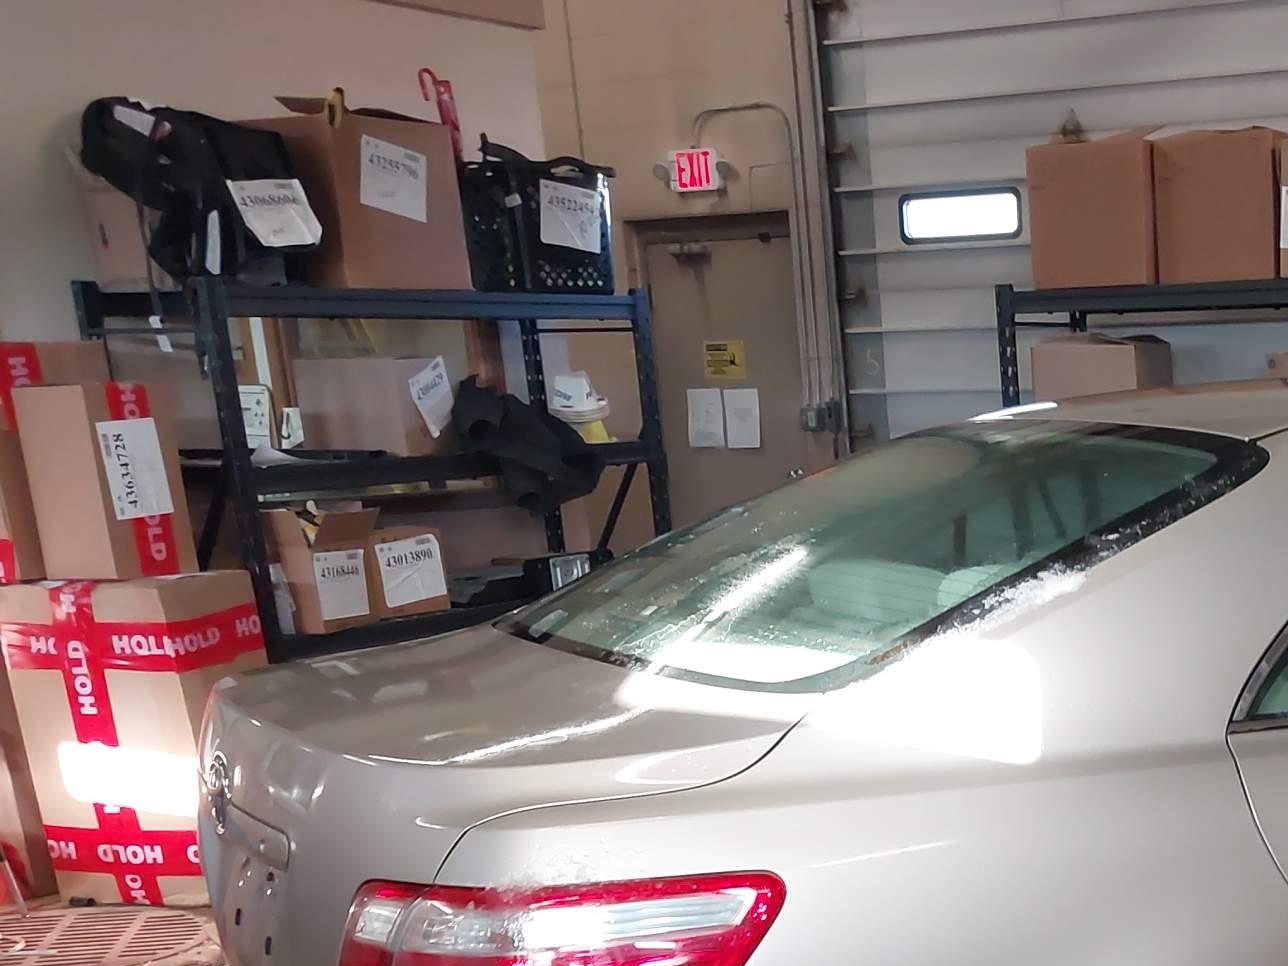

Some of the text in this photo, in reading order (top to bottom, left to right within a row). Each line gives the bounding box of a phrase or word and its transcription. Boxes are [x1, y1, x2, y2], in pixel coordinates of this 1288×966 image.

[676, 151, 711, 189] EXIT
[112, 432, 140, 509] 43634728
[384, 548, 433, 569] 43013890
[66, 640, 99, 716] HOLD
[96, 843, 164, 865] HOLD
